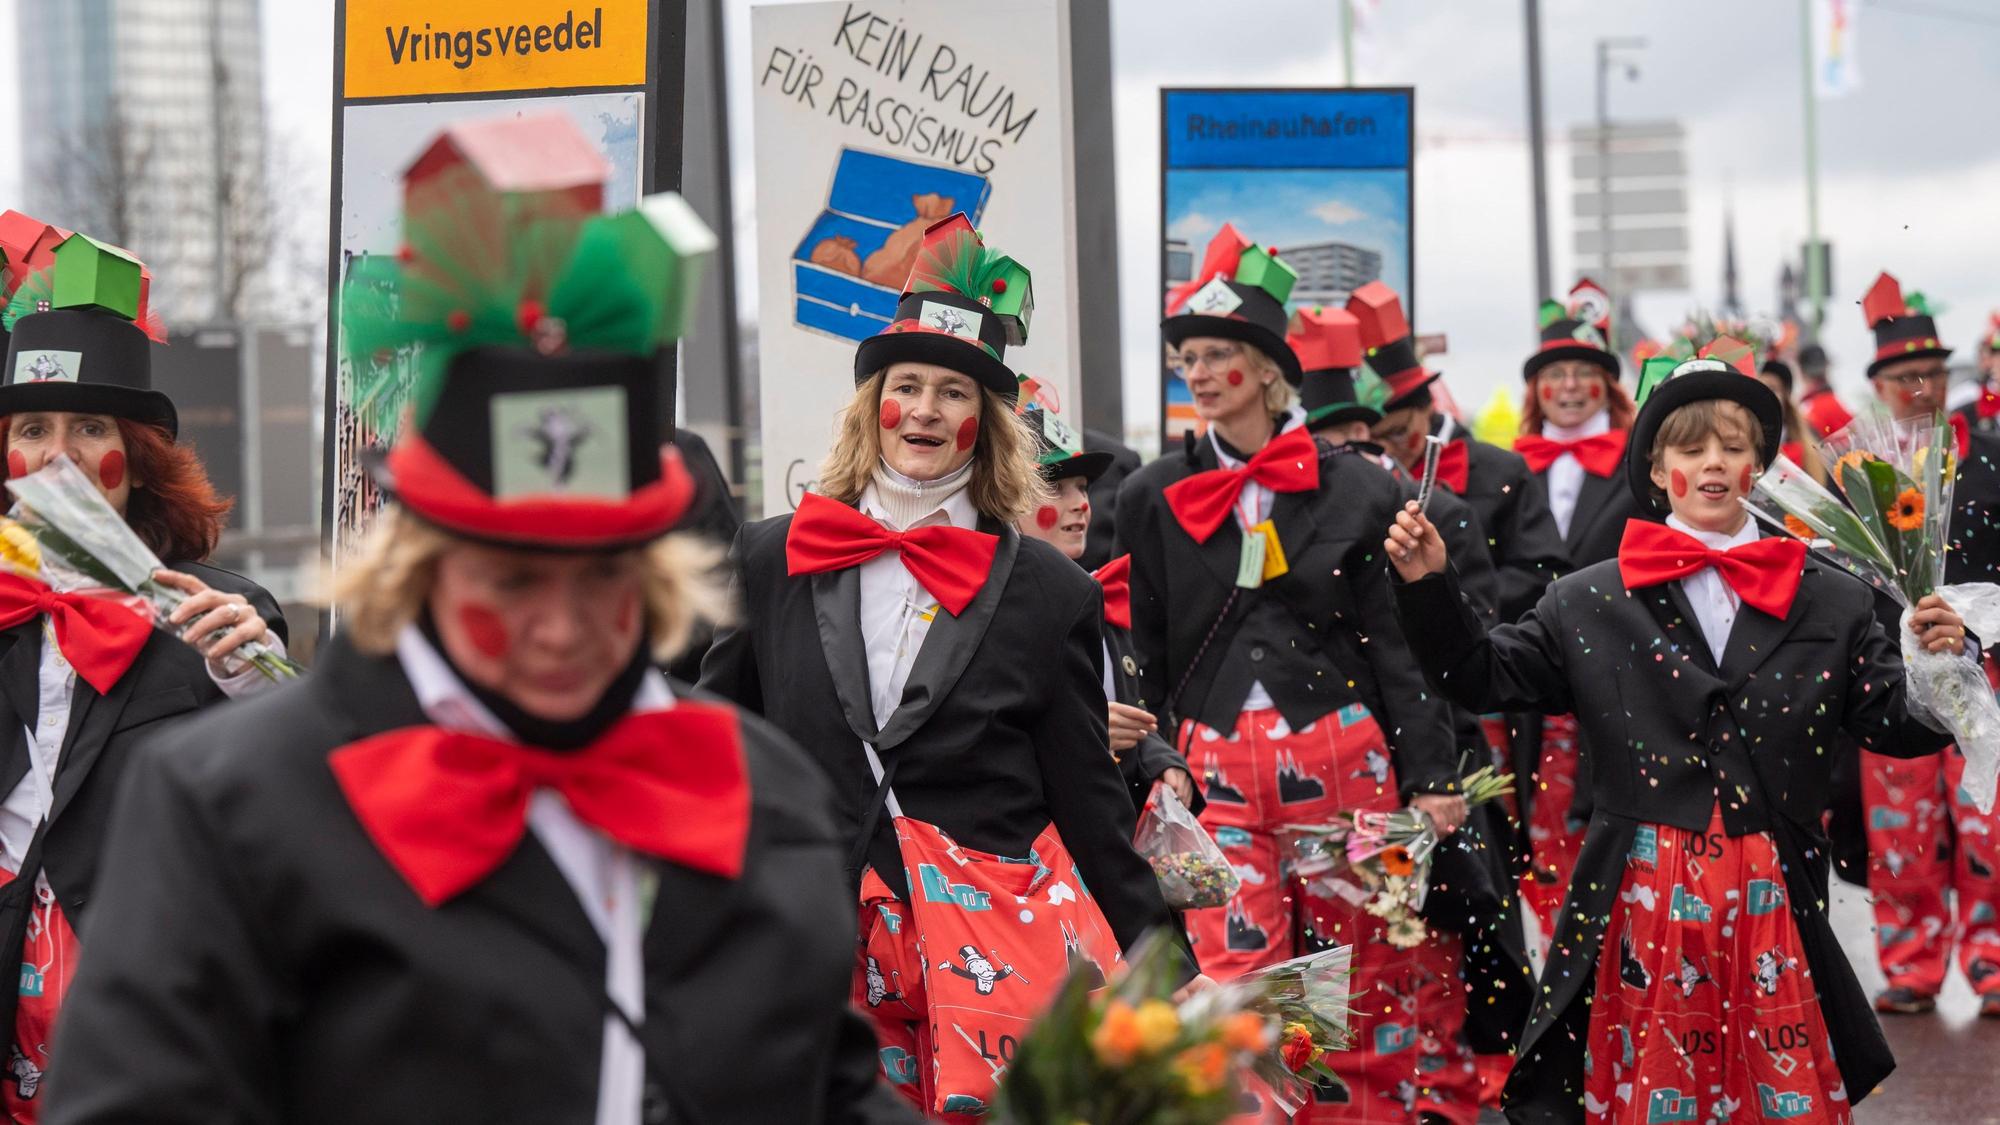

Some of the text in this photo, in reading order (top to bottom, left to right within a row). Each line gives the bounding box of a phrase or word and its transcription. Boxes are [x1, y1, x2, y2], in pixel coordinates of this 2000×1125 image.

[385, 7, 602, 69] Vringsveedel
[761, 46, 823, 109] FÜR
[920, 45, 1038, 144] RAUM
[1764, 1023, 1809, 1052] LOS
